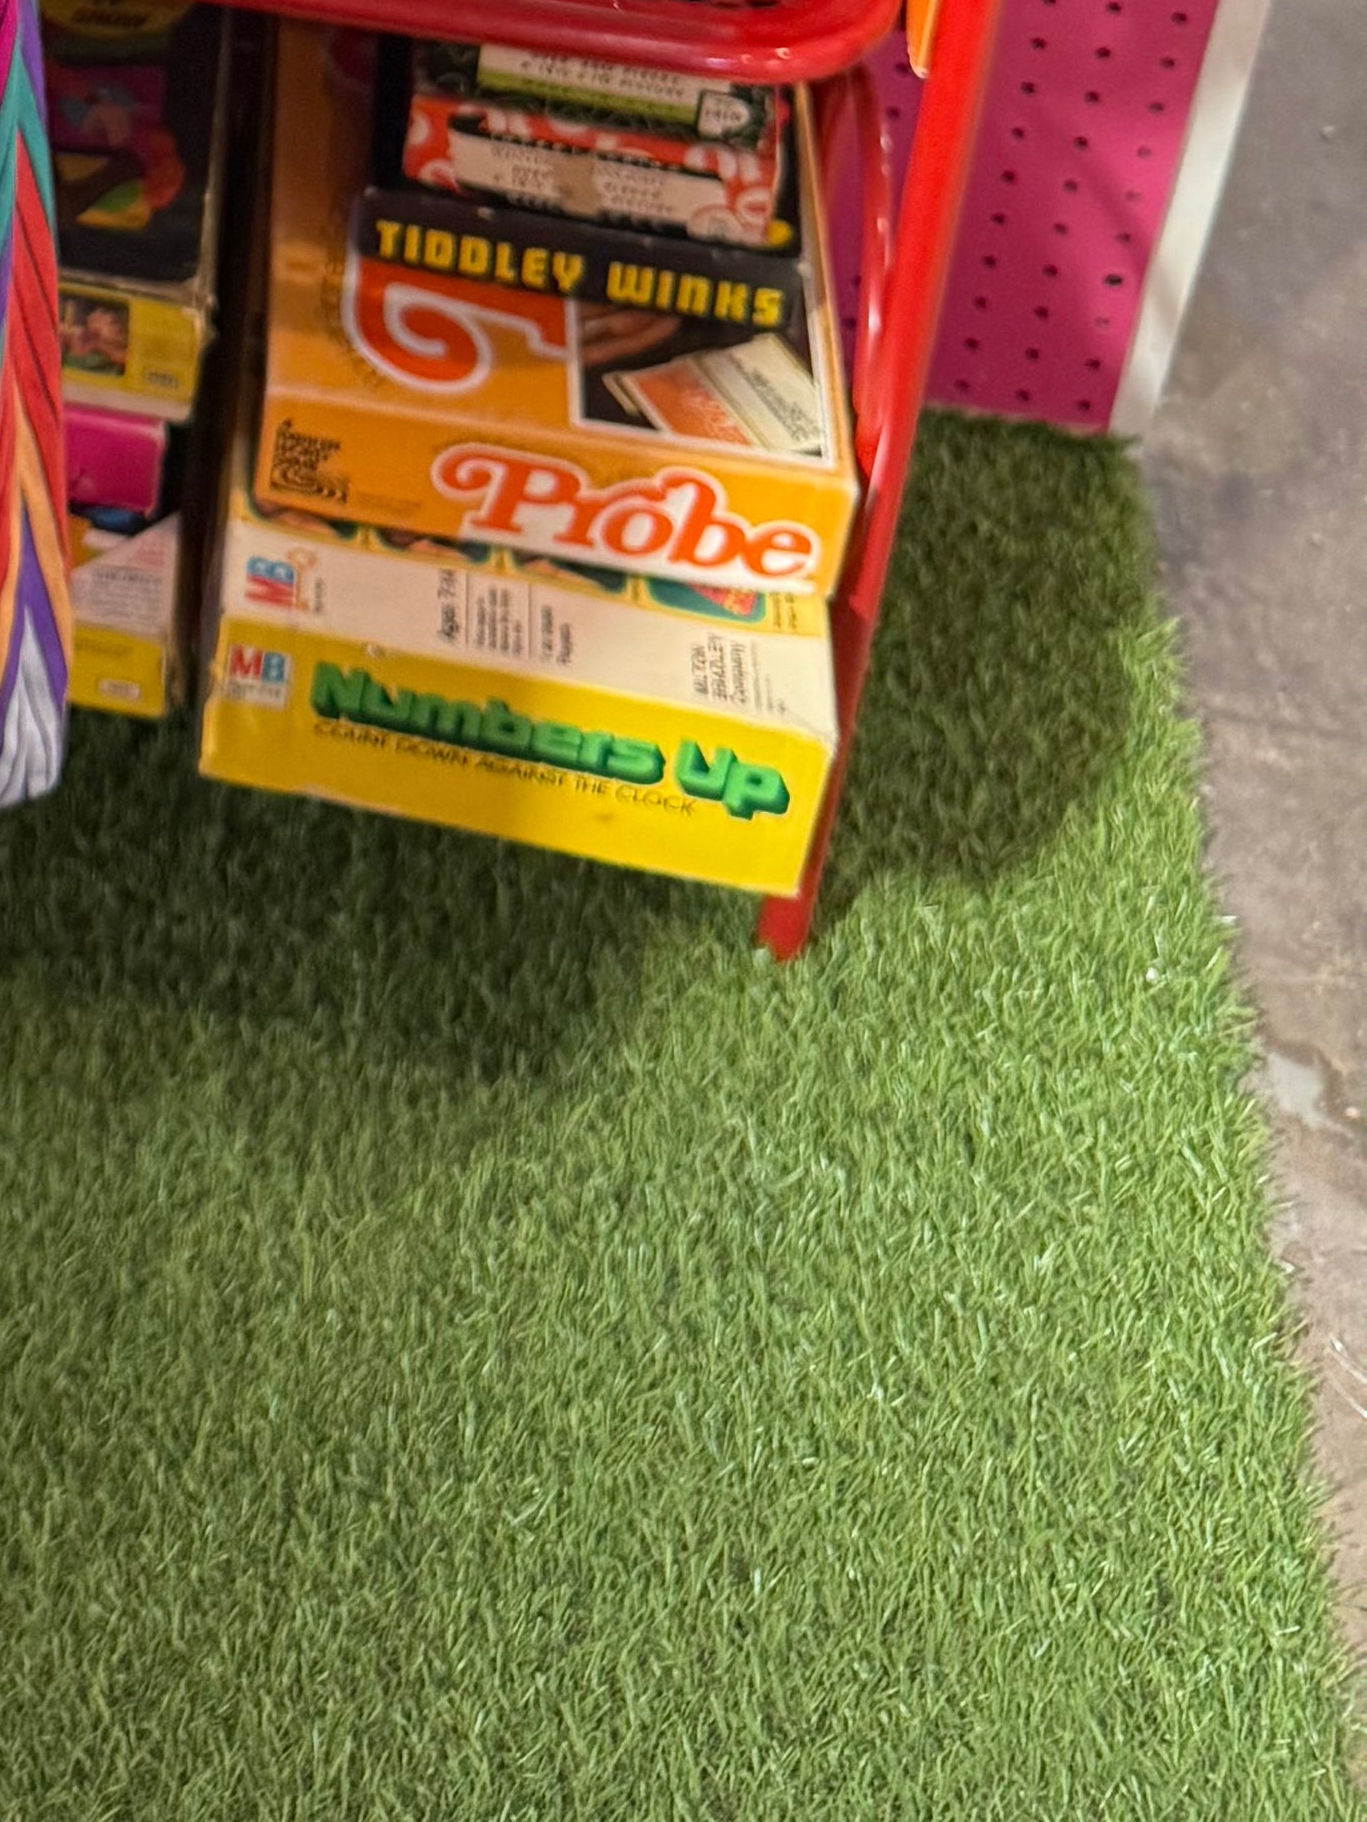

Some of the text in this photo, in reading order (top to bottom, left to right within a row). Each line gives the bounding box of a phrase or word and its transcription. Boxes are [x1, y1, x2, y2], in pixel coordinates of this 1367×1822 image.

[374, 218, 785, 329] TIDDLEY WINKS
[439, 448, 816, 579] Probe
[230, 644, 287, 683] MB
[310, 661, 665, 785] Numbers
[673, 738, 792, 820] Up
[573, 773, 609, 796] THE
[613, 782, 698, 817] CLOCK
